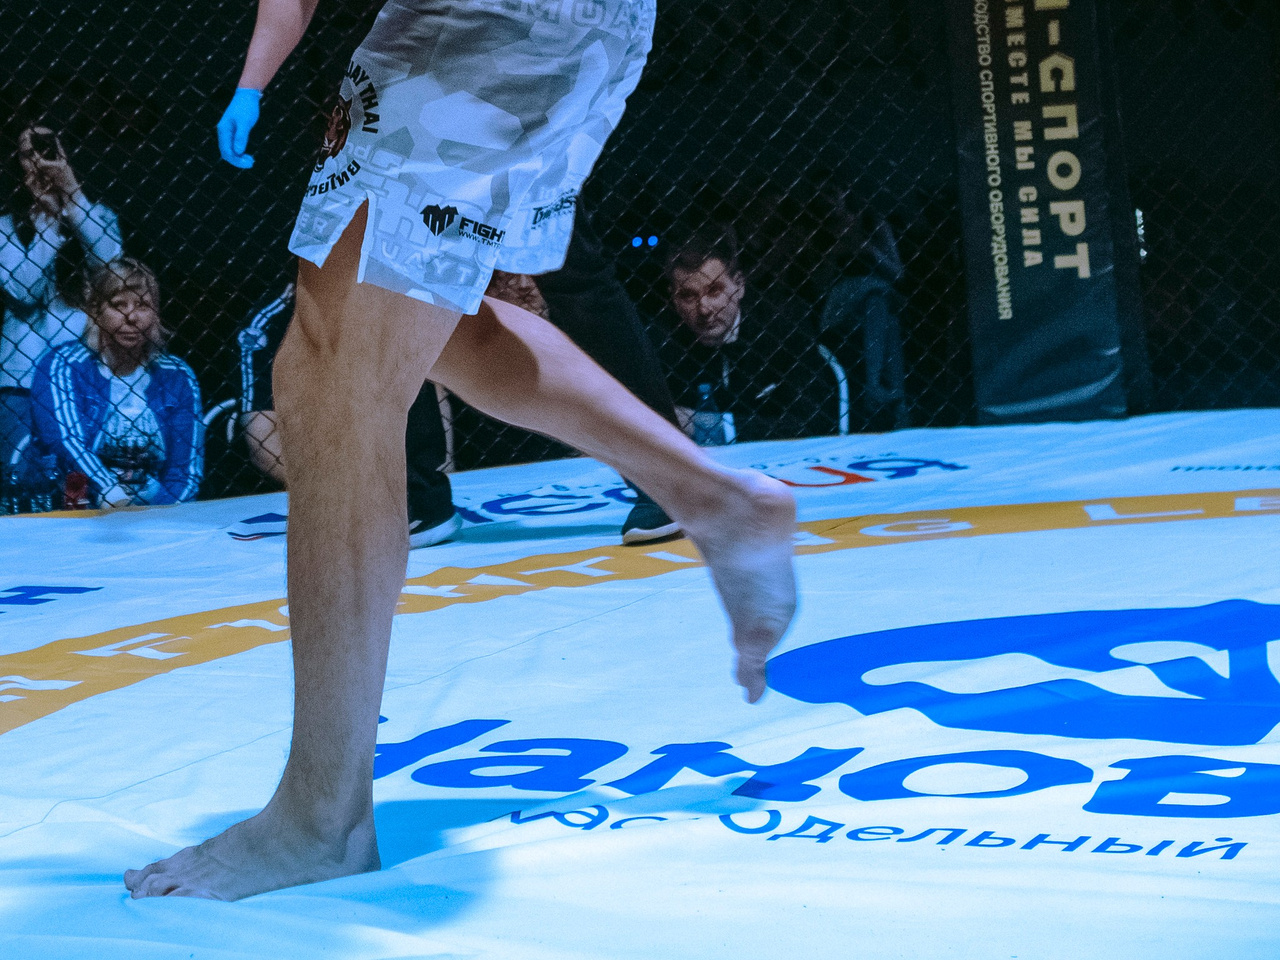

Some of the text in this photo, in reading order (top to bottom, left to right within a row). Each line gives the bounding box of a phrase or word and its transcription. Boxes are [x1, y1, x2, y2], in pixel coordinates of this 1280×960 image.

[358, 81, 381, 135] THAI
[980, 68, 1002, 187] СПОРТИВНОГО
[1013, 120, 1035, 171] МЫ
[459, 216, 506, 243] FIGH
[989, 187, 1014, 321] ОБОРУДОВАНИЯ
[1018, 185, 1044, 268] СИЛА
